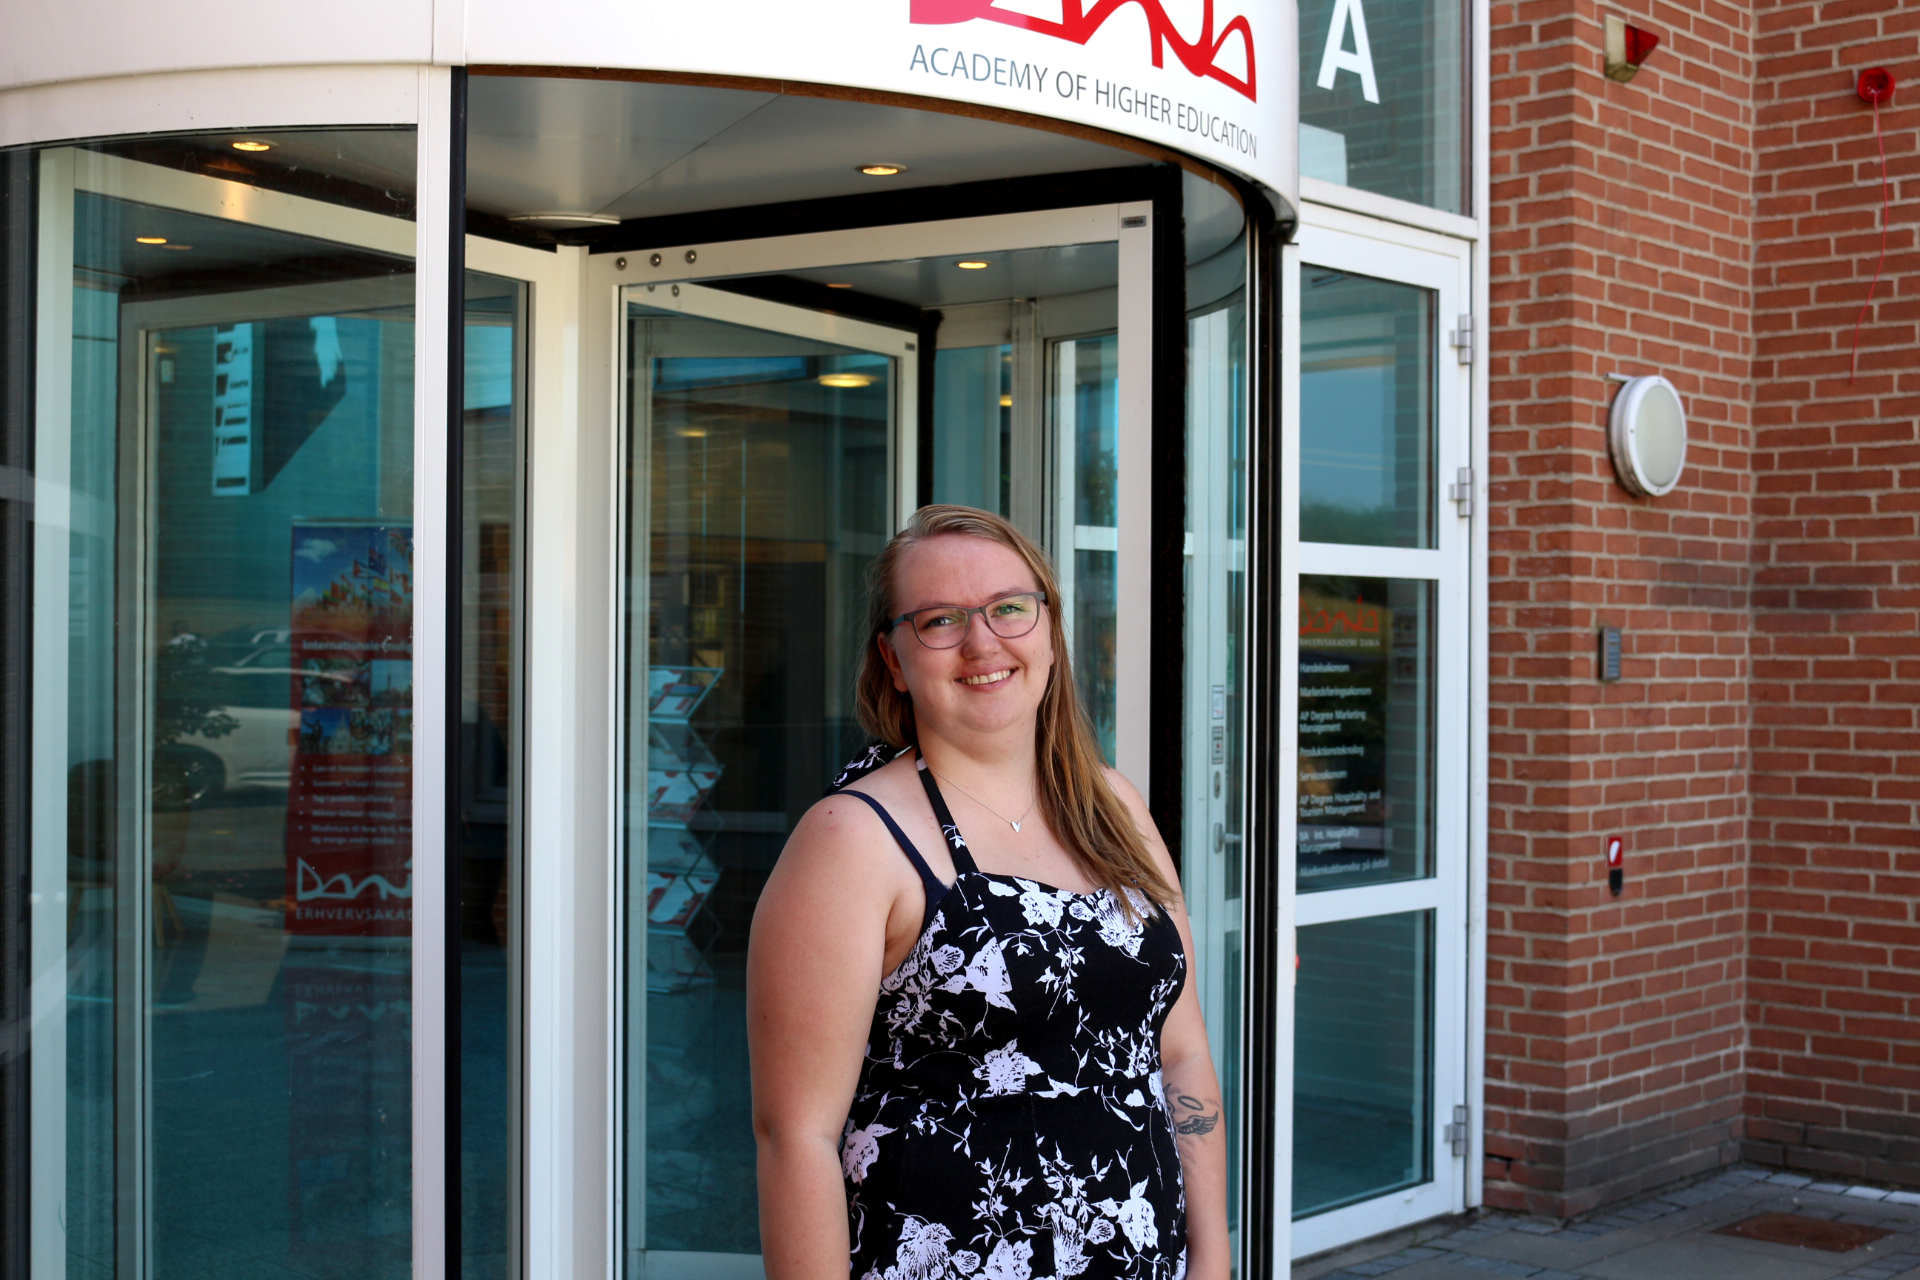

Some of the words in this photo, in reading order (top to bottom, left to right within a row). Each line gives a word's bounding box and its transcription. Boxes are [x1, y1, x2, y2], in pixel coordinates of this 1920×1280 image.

[909, 44, 1048, 93] ACADEMY
[1055, 70, 1087, 103] OF
[1095, 78, 1172, 126] HIGHER
[1177, 104, 1257, 160] EDUCATION
[1316, 0, 1381, 104] A
